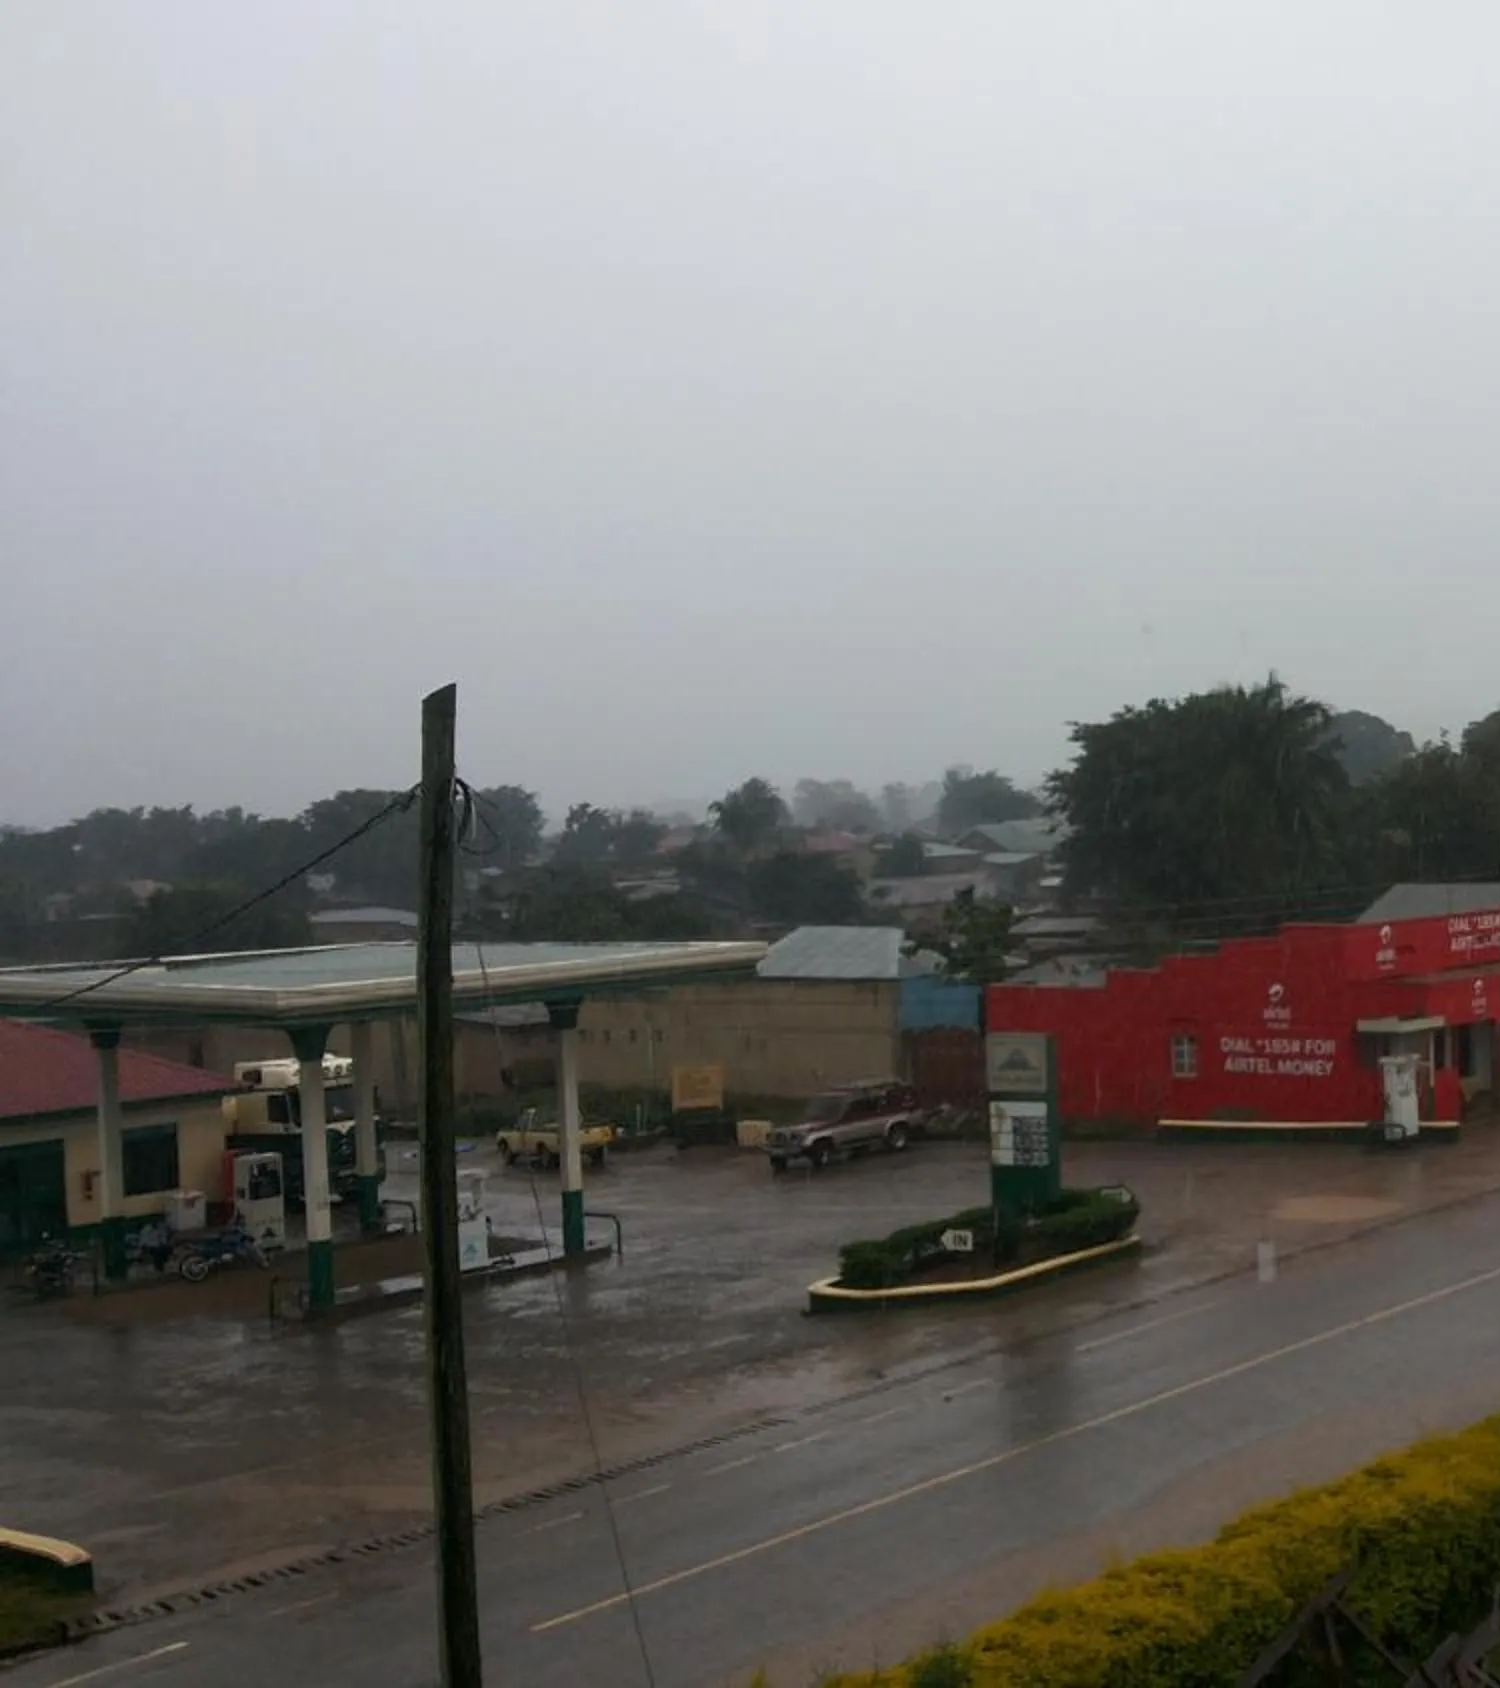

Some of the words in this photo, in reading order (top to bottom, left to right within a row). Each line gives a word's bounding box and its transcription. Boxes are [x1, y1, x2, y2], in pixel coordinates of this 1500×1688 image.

[1220, 1036, 1255, 1054] DIAL
[1304, 1039, 1336, 1056] FOR
[1224, 1055, 1274, 1074] AIRTEL
[1277, 1058, 1334, 1076] MONEY
[952, 1232, 968, 1248] IN
